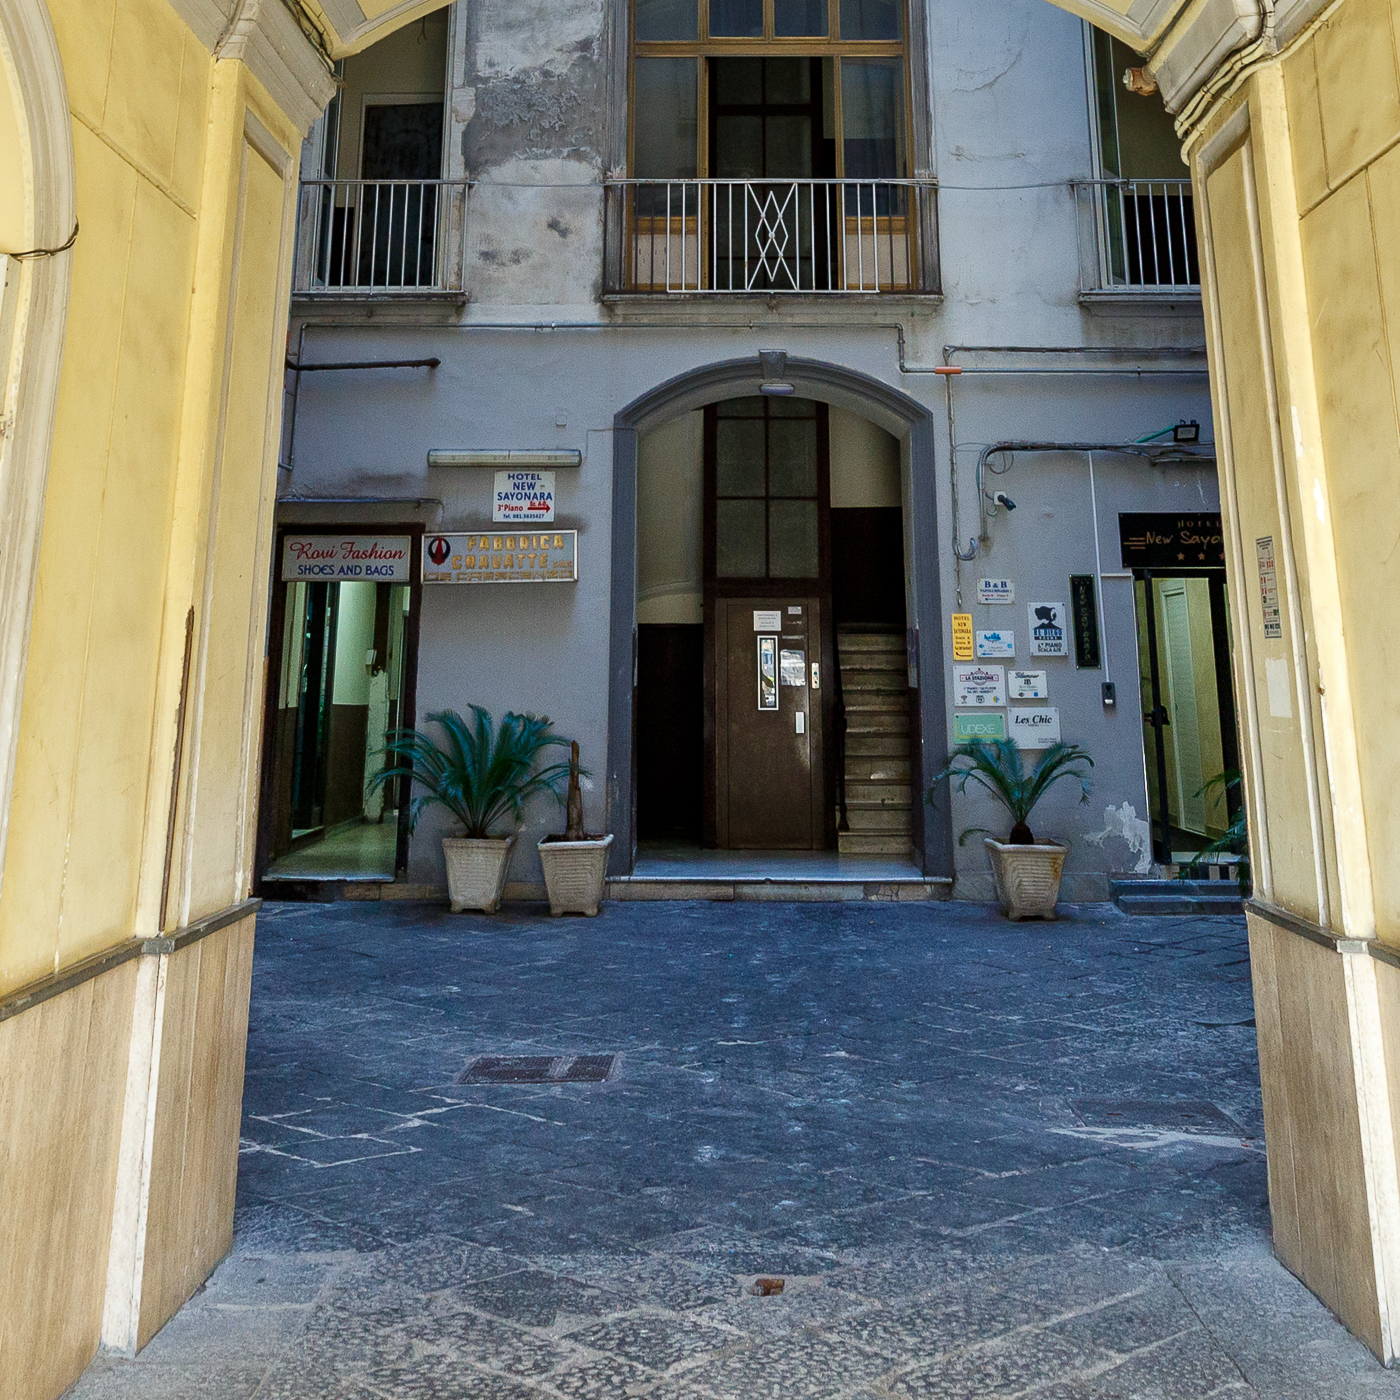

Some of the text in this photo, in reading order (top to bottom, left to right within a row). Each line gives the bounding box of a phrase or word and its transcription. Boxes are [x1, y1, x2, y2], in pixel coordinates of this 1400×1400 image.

[512, 482, 536, 490] NEW
[497, 492, 553, 500] SAYONARA
[467, 535, 564, 551] FABBRICA
[1146, 531, 1173, 544] New
[289, 541, 406, 560] Rovi Fashion
[452, 554, 548, 570] CRAVATTE
[297, 564, 394, 576] SHOES AND BAGS
[1015, 714, 1052, 724] Les Chic
